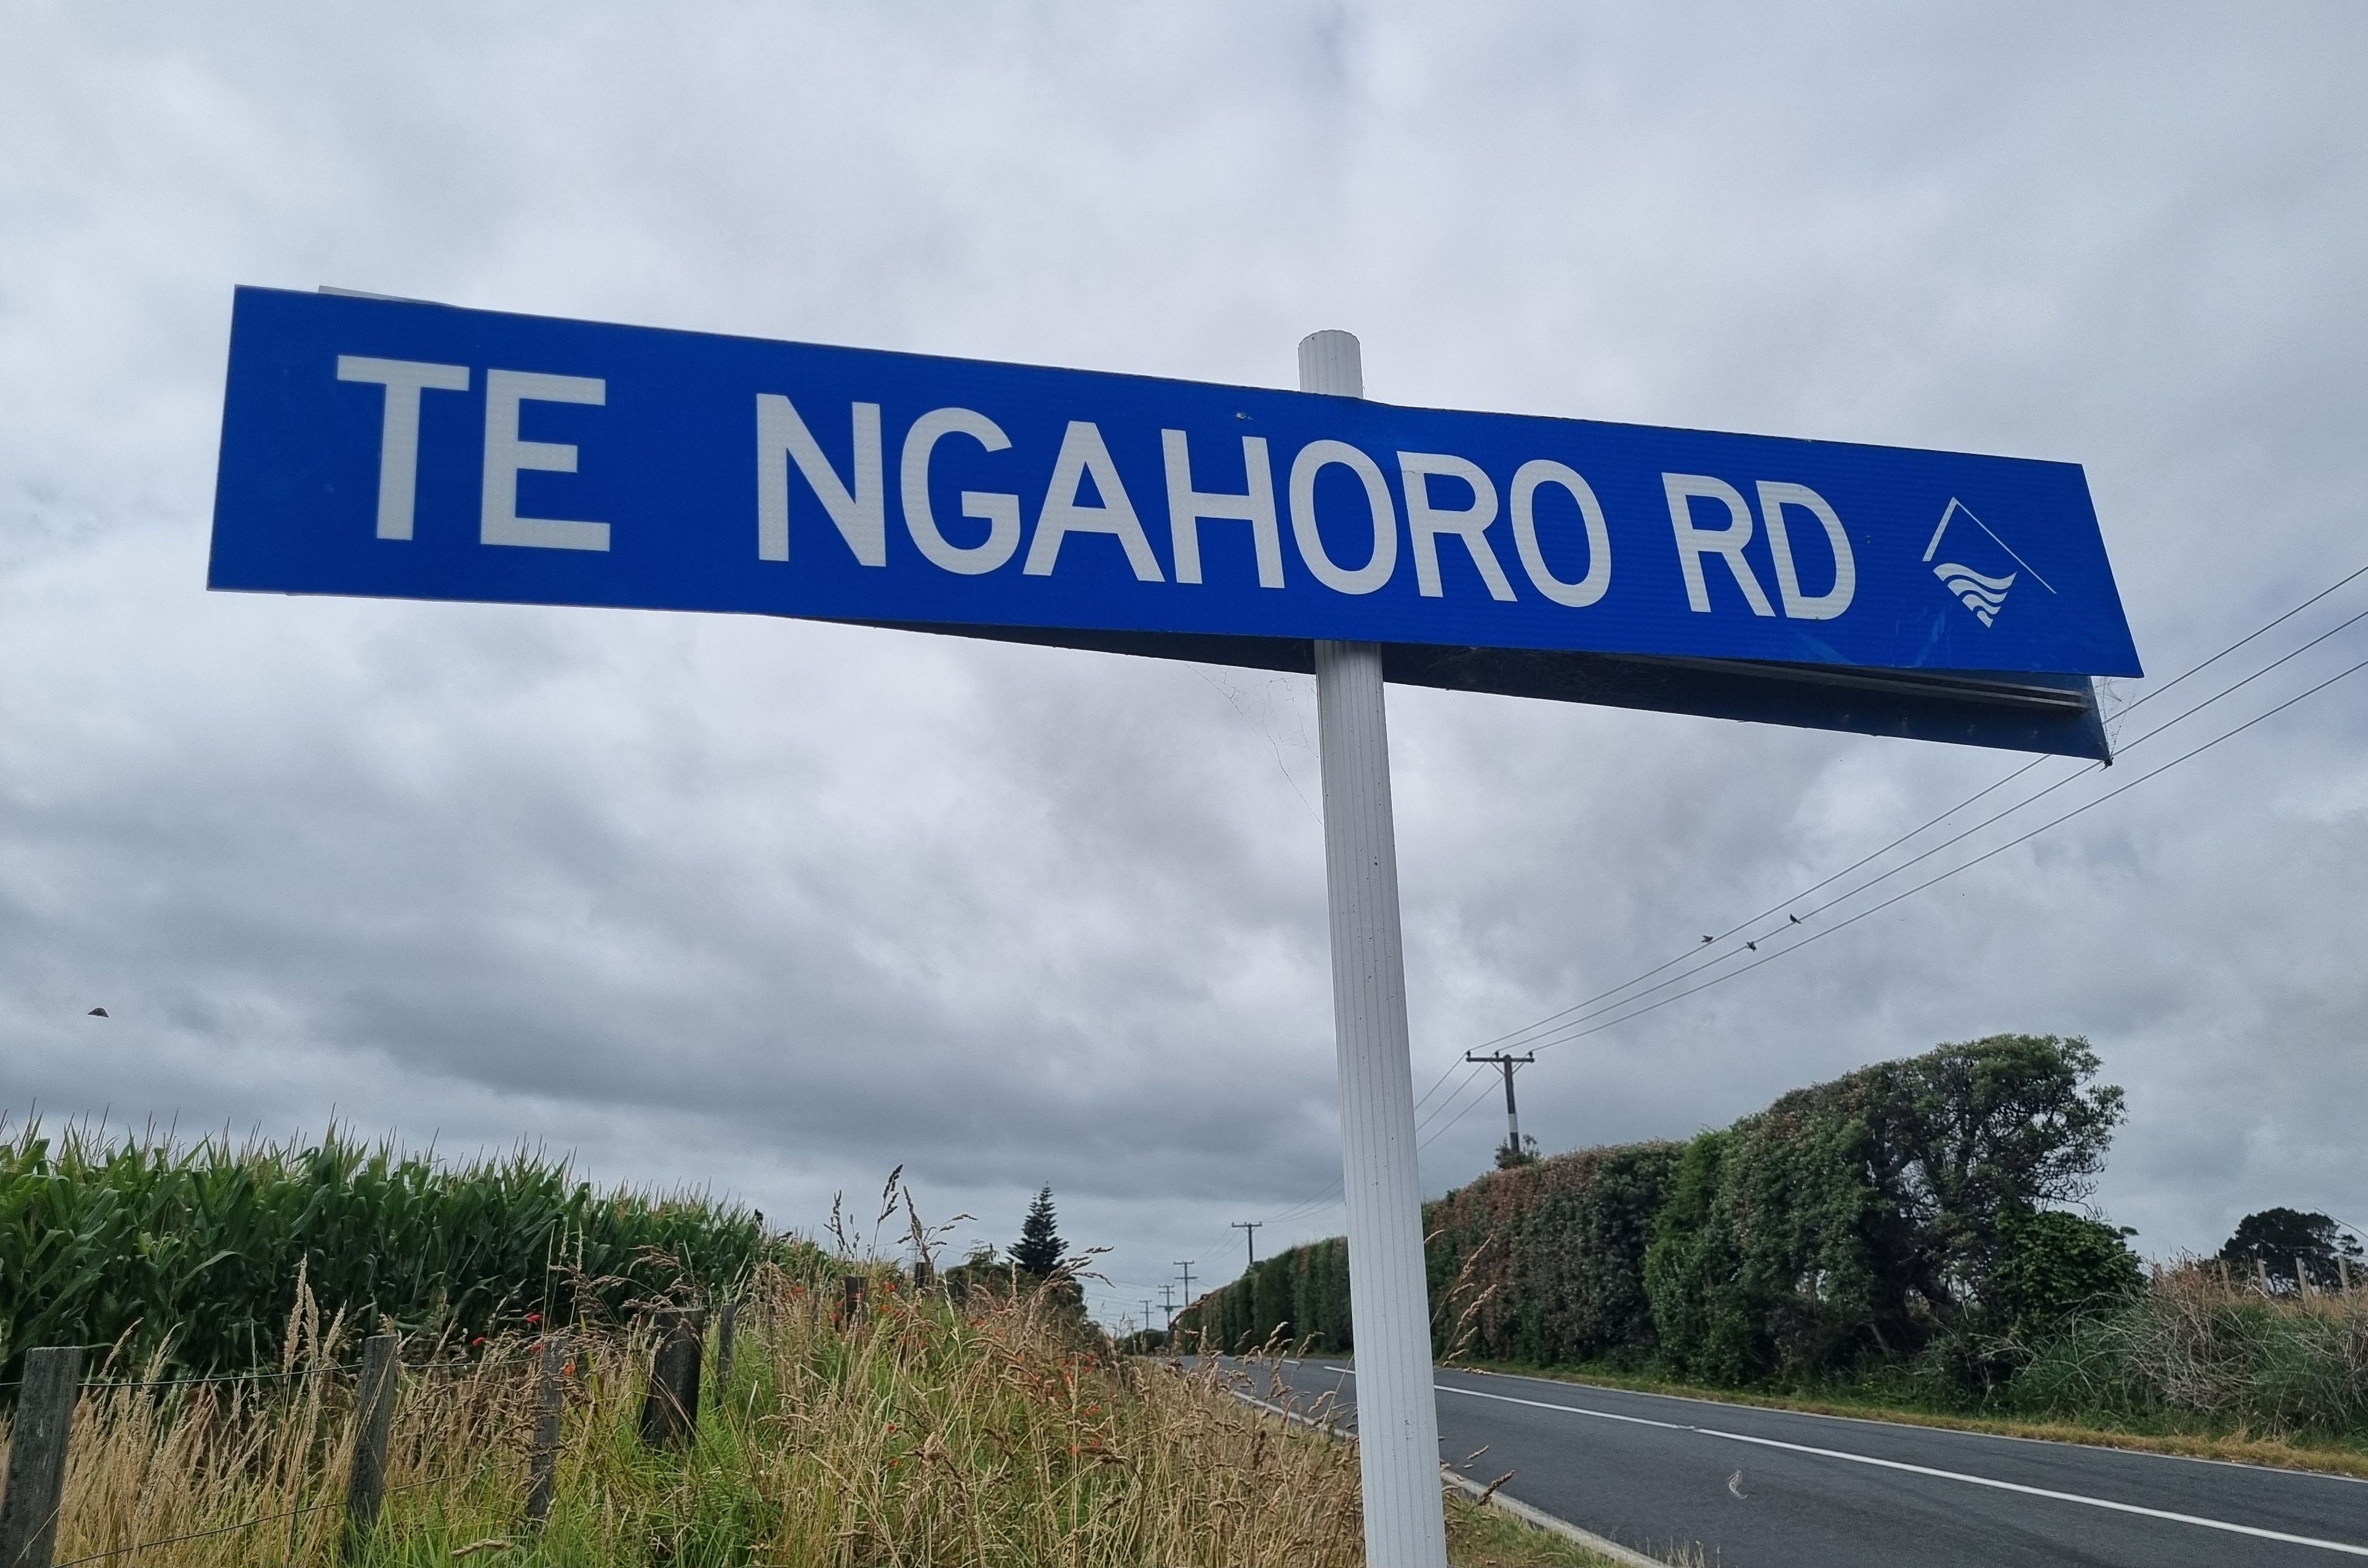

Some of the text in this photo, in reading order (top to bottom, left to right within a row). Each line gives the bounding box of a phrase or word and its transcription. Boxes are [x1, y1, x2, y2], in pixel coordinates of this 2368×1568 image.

[337, 355, 1856, 620] TE NGAHORO RD
